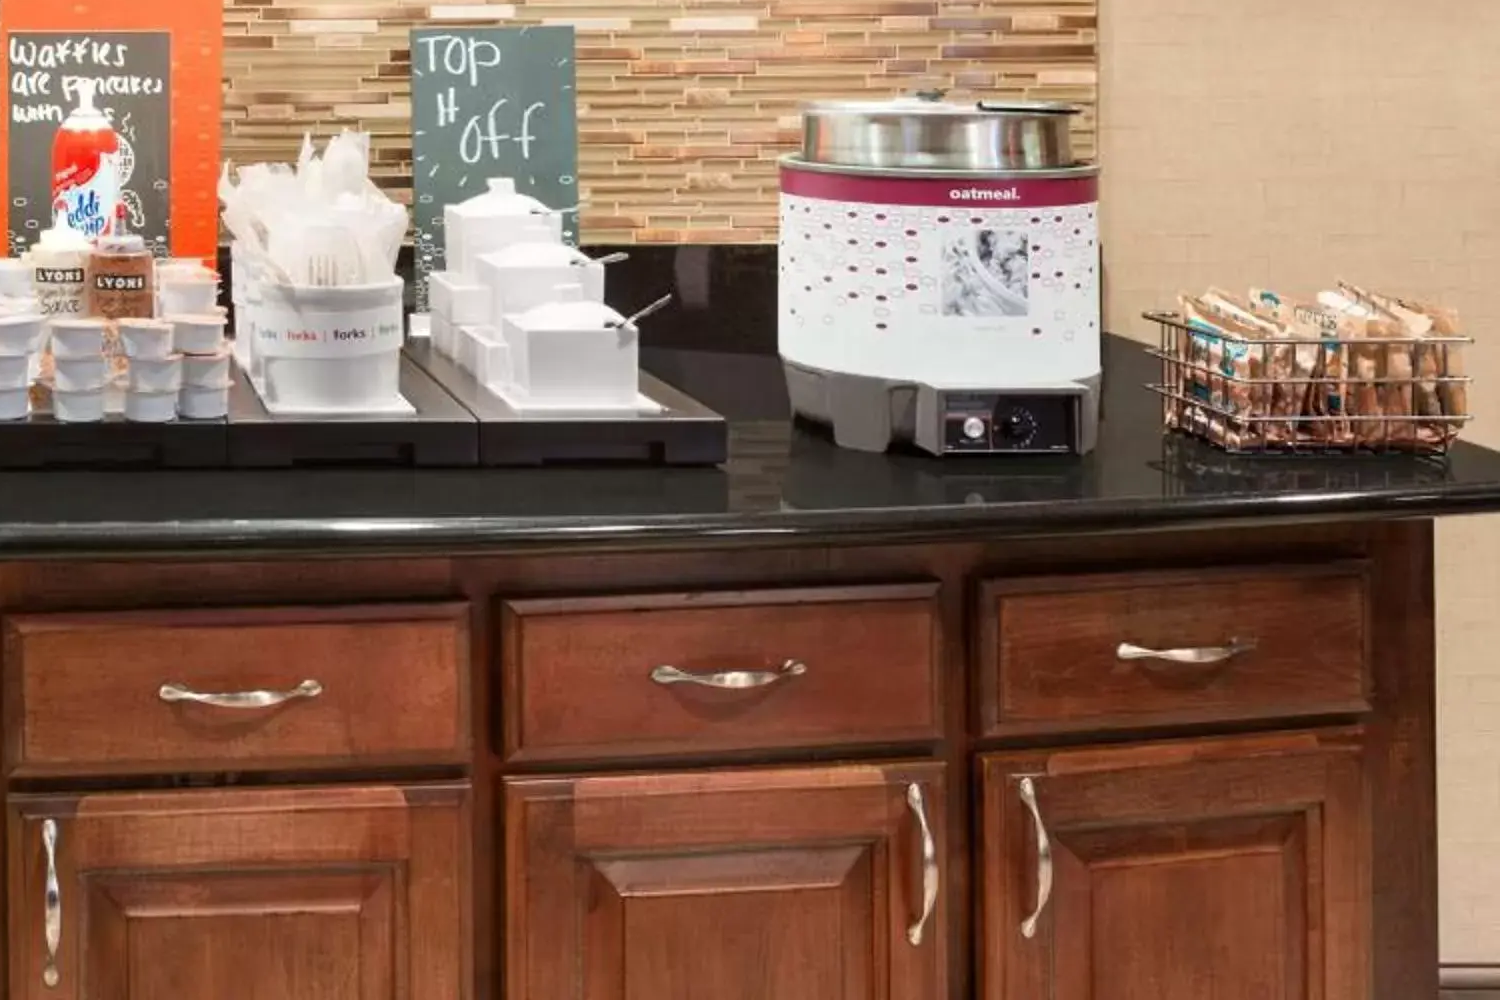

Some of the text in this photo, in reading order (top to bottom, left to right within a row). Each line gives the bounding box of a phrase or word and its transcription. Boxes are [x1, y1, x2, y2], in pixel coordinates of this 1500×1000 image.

[12, 72, 163, 101] are pncakes
[949, 187, 1020, 200] oatmeal.
[68, 190, 100, 228] eddi
[39, 271, 82, 282] LYONS
[97, 276, 143, 289] LYONS
[333, 328, 366, 341] forks
